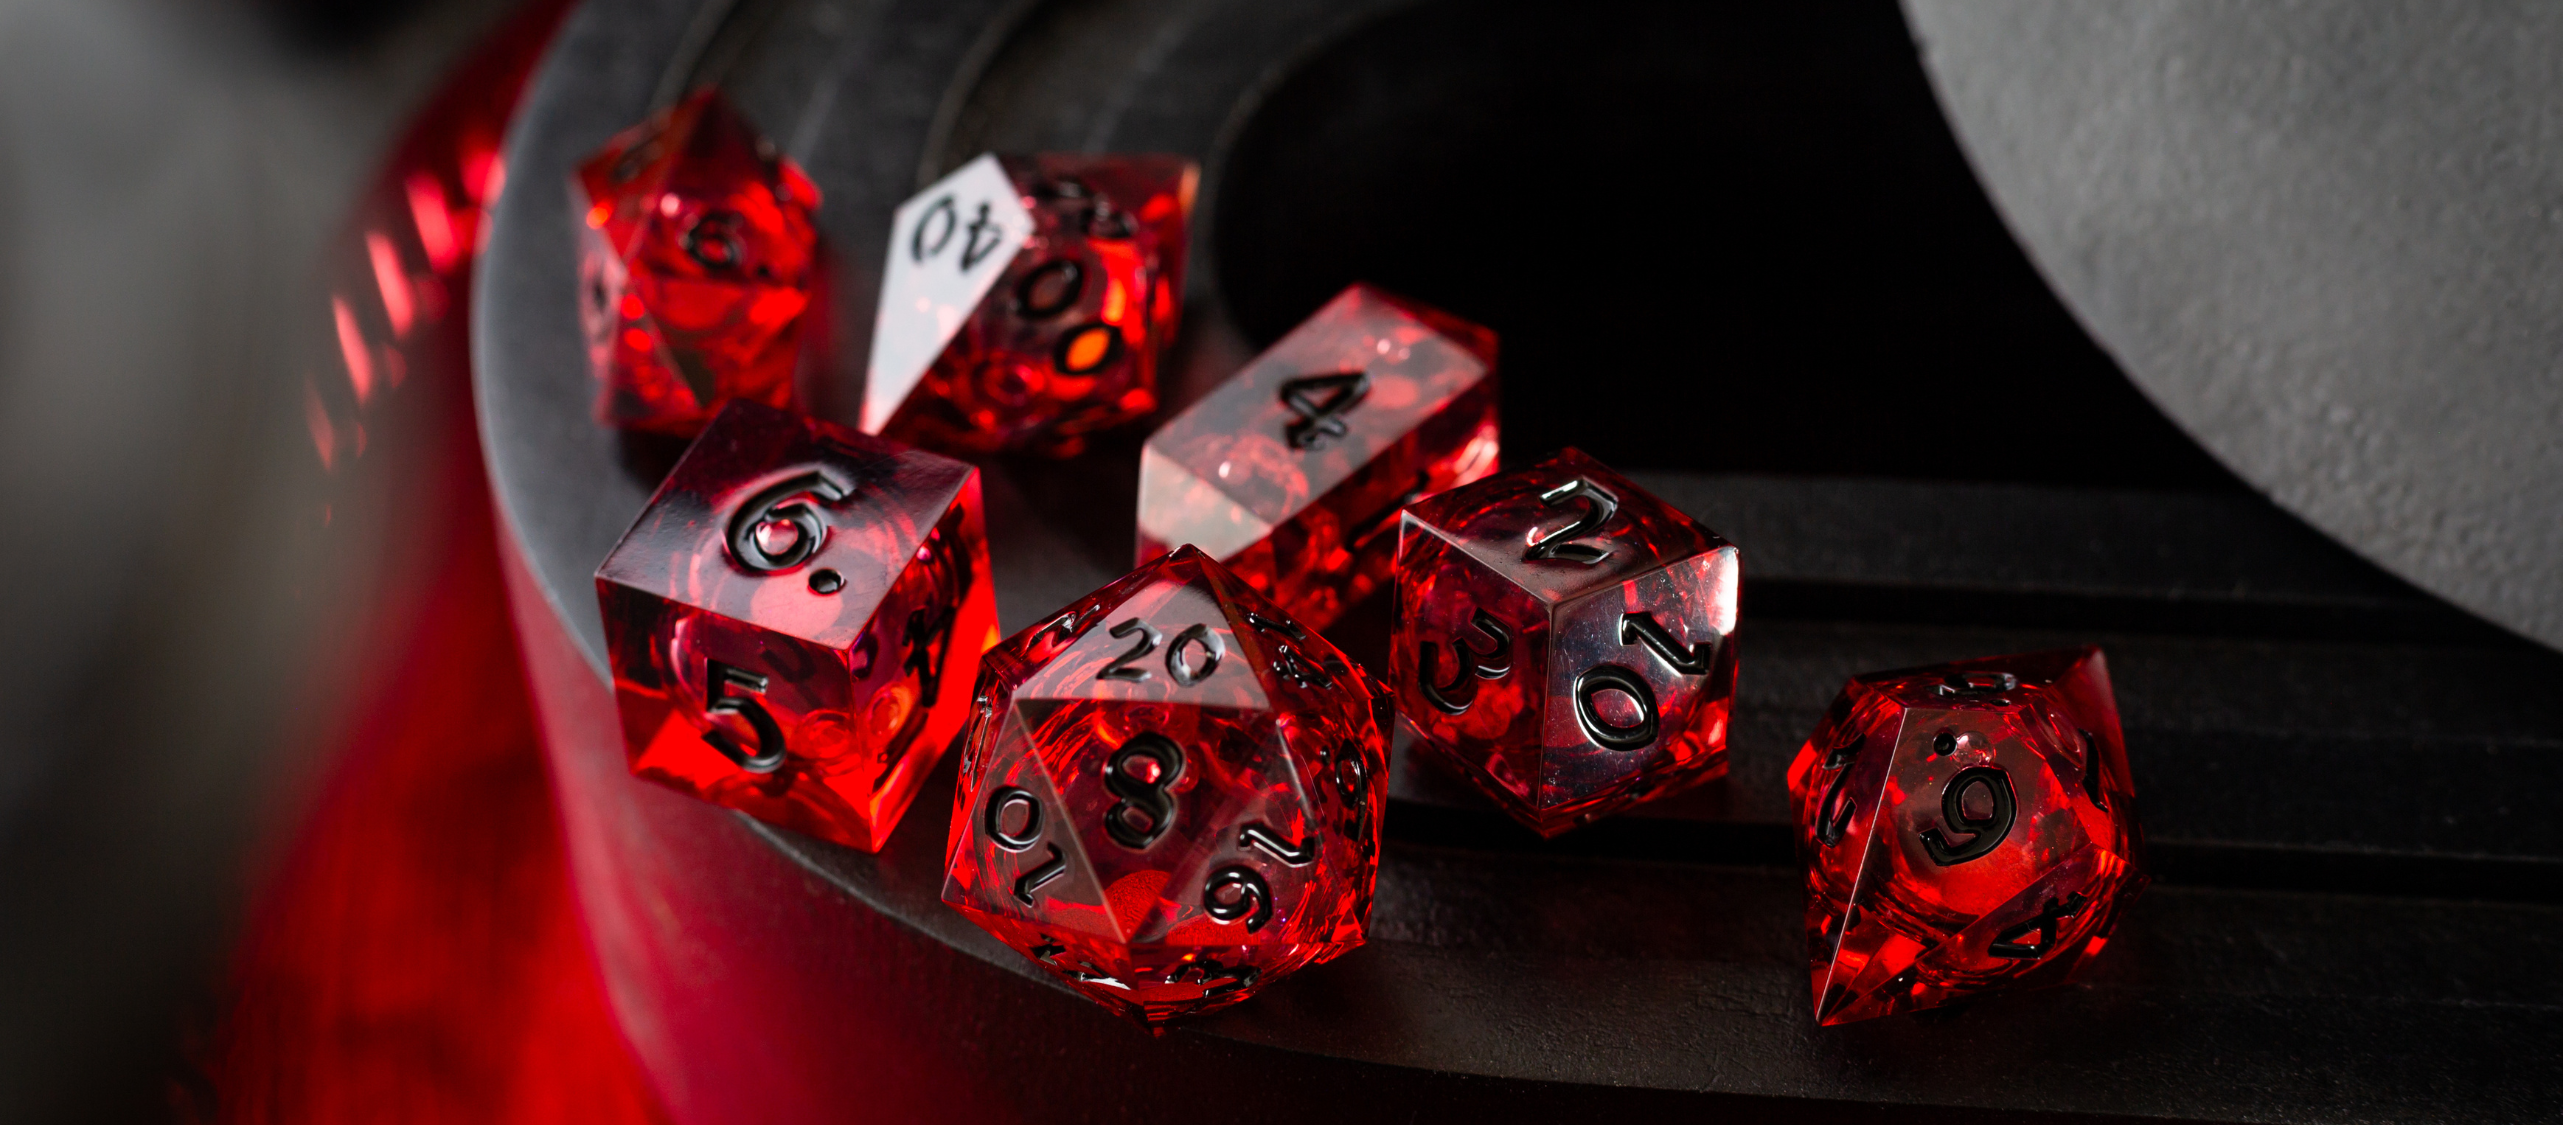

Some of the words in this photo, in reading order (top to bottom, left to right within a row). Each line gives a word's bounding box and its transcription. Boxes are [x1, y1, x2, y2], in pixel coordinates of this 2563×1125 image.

[911, 190, 1002, 272] 40
[1279, 371, 1372, 449] 4
[1523, 476, 1619, 565] 2
[1096, 617, 1227, 687] 20
[1418, 606, 1513, 716] 3
[1573, 611, 1713, 752] 10
[703, 656, 788, 774] 5
[1102, 730, 1187, 851] 8
[984, 784, 1067, 908] 10
[1987, 890, 2088, 960] 4
